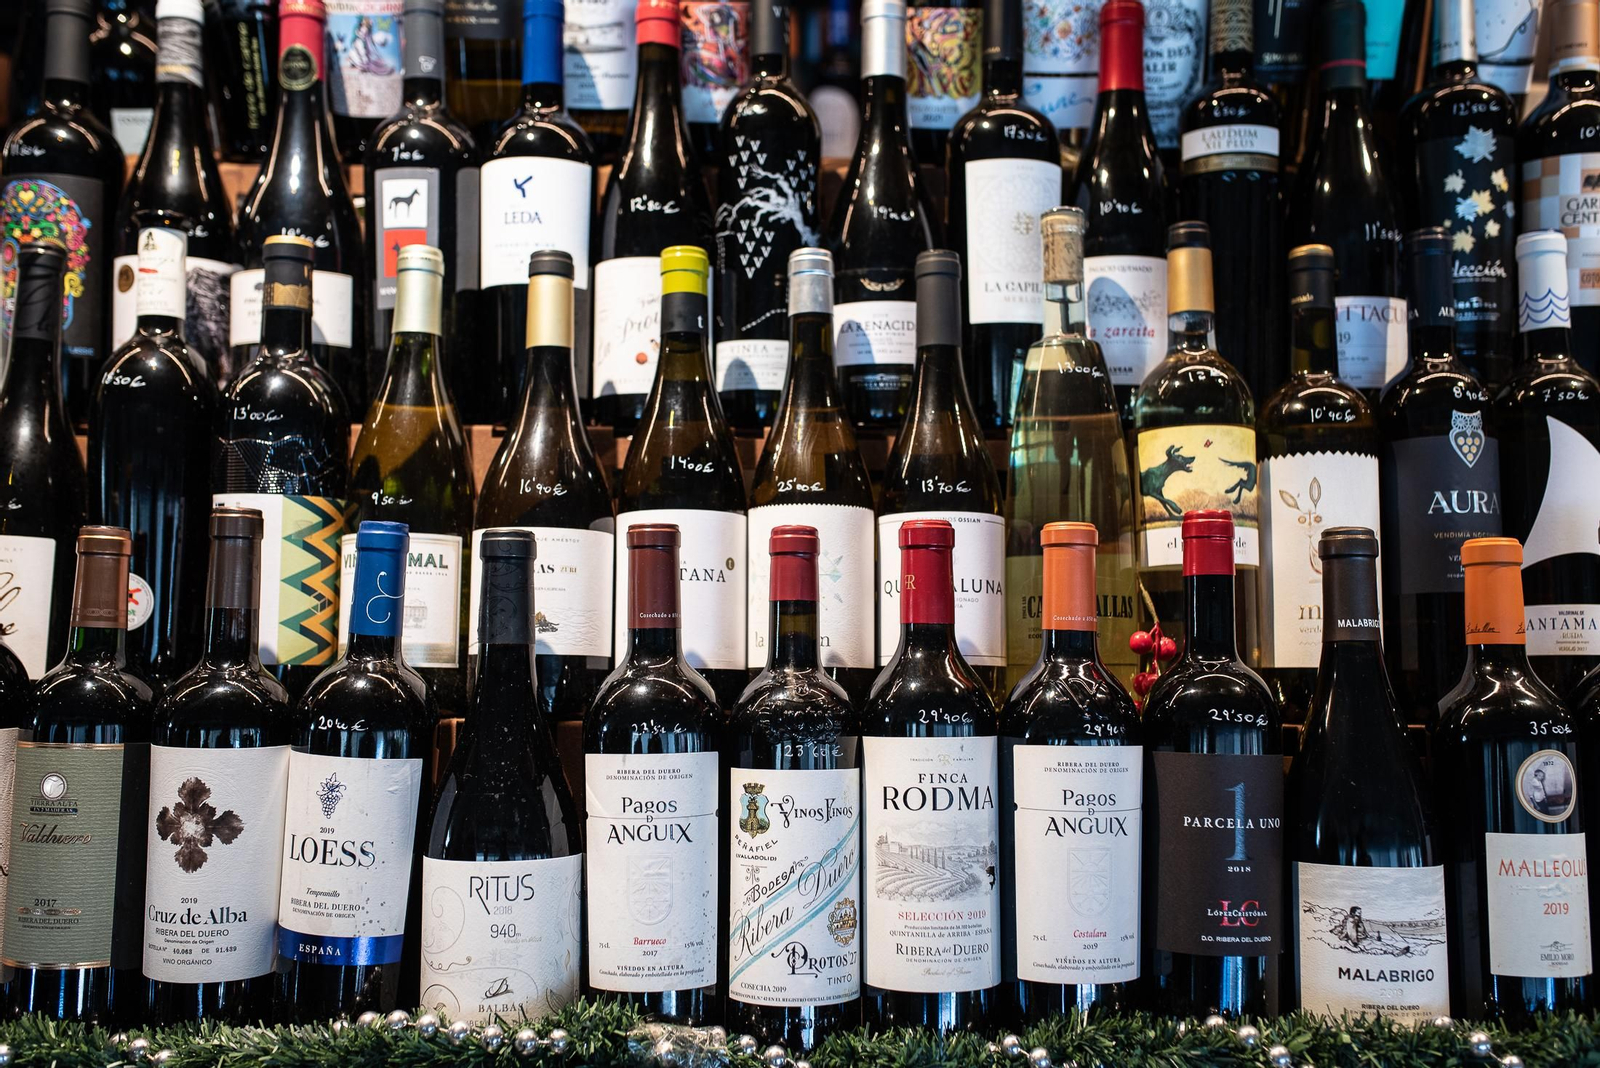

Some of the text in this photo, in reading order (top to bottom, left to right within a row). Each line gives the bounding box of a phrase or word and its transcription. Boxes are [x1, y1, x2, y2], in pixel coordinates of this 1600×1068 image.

[1201, 127, 1259, 140] LAUDUM
[1225, 137, 1256, 150] PLUS
[503, 211, 543, 226] LEDA
[984, 282, 1002, 294] LA
[1103, 322, 1156, 339] zarcita
[1427, 489, 1500, 515] AURA
[1053, 614, 1081, 622] Cosechado
[1526, 617, 1598, 631] ANTAMA
[918, 773, 969, 784] FINCA
[31, 799, 55, 807] TIERRA
[883, 786, 994, 812] RODMA
[1062, 789, 1117, 807] Pagos
[621, 797, 678, 814] Pagos
[1045, 816, 1129, 838] ANGUIX
[1183, 815, 1281, 829] PARCELA UNO
[1223, 781, 1254, 861] 1
[20, 823, 92, 845] Valduero
[319, 827, 335, 835] 2019
[607, 822, 694, 845] ANGUIX
[734, 834, 779, 853] PEÑAFIEL
[289, 833, 376, 868] LOESS
[305, 887, 341, 898] Tempranillo
[34, 898, 57, 908] 2017
[290, 897, 362, 912] RIBERA DEL DUERO
[732, 848, 857, 961] Ribera Duero
[1543, 902, 1570, 916] 2019
[148, 904, 248, 925] Cruz de Alba
[292, 907, 325, 917] DENOMINACIÓN
[493, 905, 513, 915] 2018
[898, 910, 987, 921] SELECCIÓN 2019
[18, 916, 79, 925] RIBERA DEL DUERO
[155, 927, 230, 938] RIBERA DEL DUERO
[889, 929, 937, 938] QUINTANILLA
[975, 928, 993, 937] ESPAÑA
[1073, 928, 1107, 939] Costalara
[1216, 935, 1240, 943] RIBERA
[1254, 935, 1272, 943] DUERO
[633, 936, 667, 946] Barrueco
[298, 943, 342, 956] ESPAÑA
[896, 942, 942, 957] RIBERA
[952, 942, 990, 956] DUERO
[162, 957, 213, 966] VINO ORGÁNICO
[1055, 955, 1087, 965] VIÑEDOS
[826, 973, 853, 986] TINTO
[1338, 966, 1435, 983] MALABRIGO
[740, 982, 787, 993] COSECHA 2019
[1361, 1003, 1386, 1011] RIBERA
